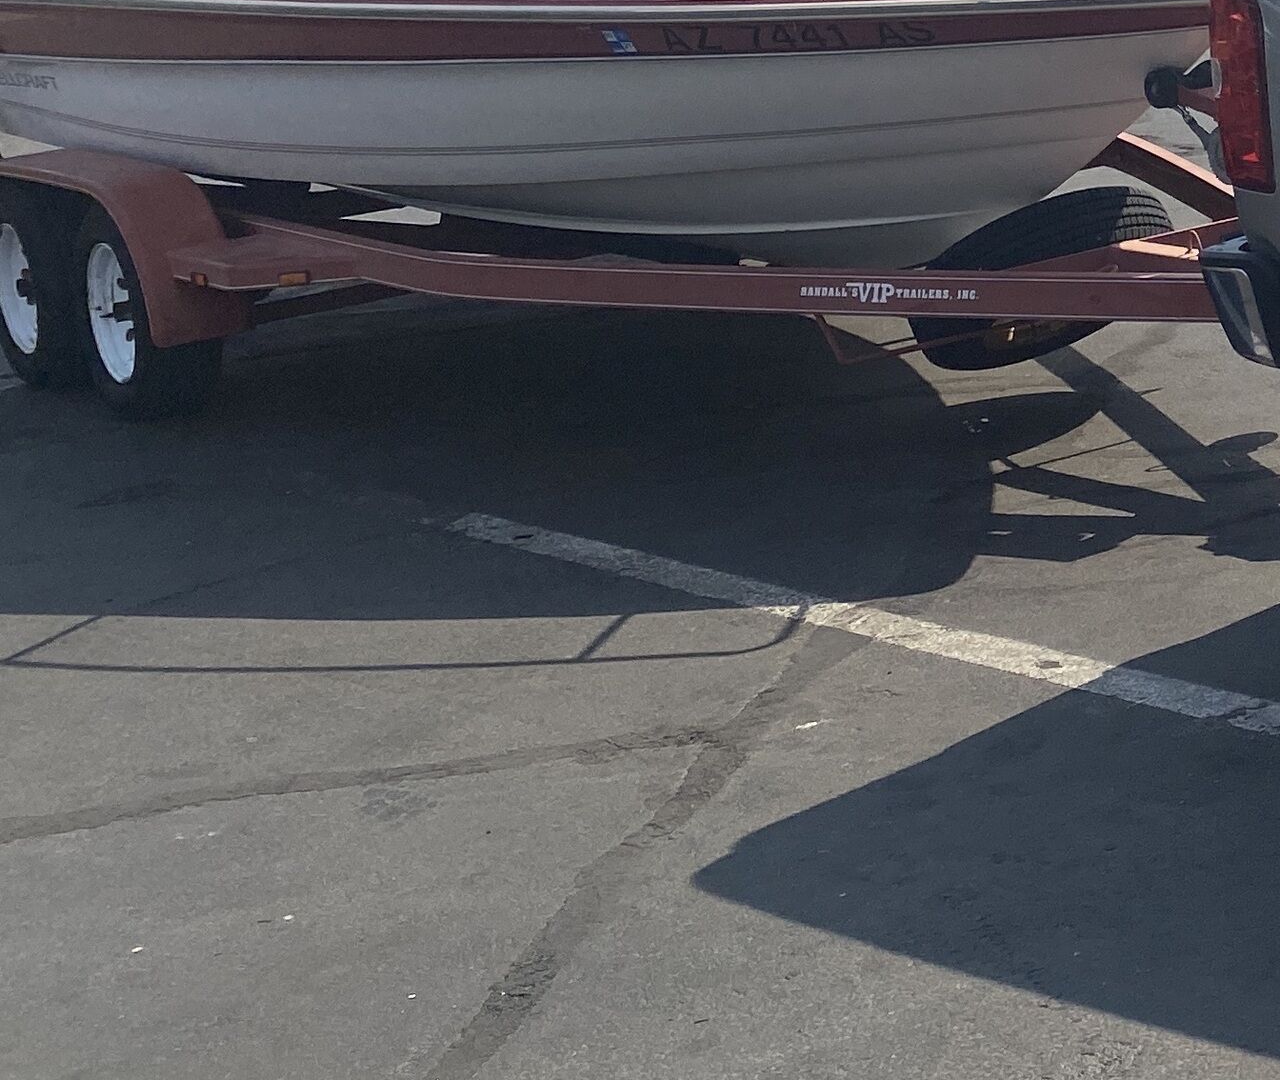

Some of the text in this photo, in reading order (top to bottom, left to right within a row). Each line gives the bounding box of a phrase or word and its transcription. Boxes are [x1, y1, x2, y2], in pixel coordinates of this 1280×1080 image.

[662, 24, 723, 51] AZ
[879, 21, 935, 48] AS
[846, 282, 895, 304] VIP
